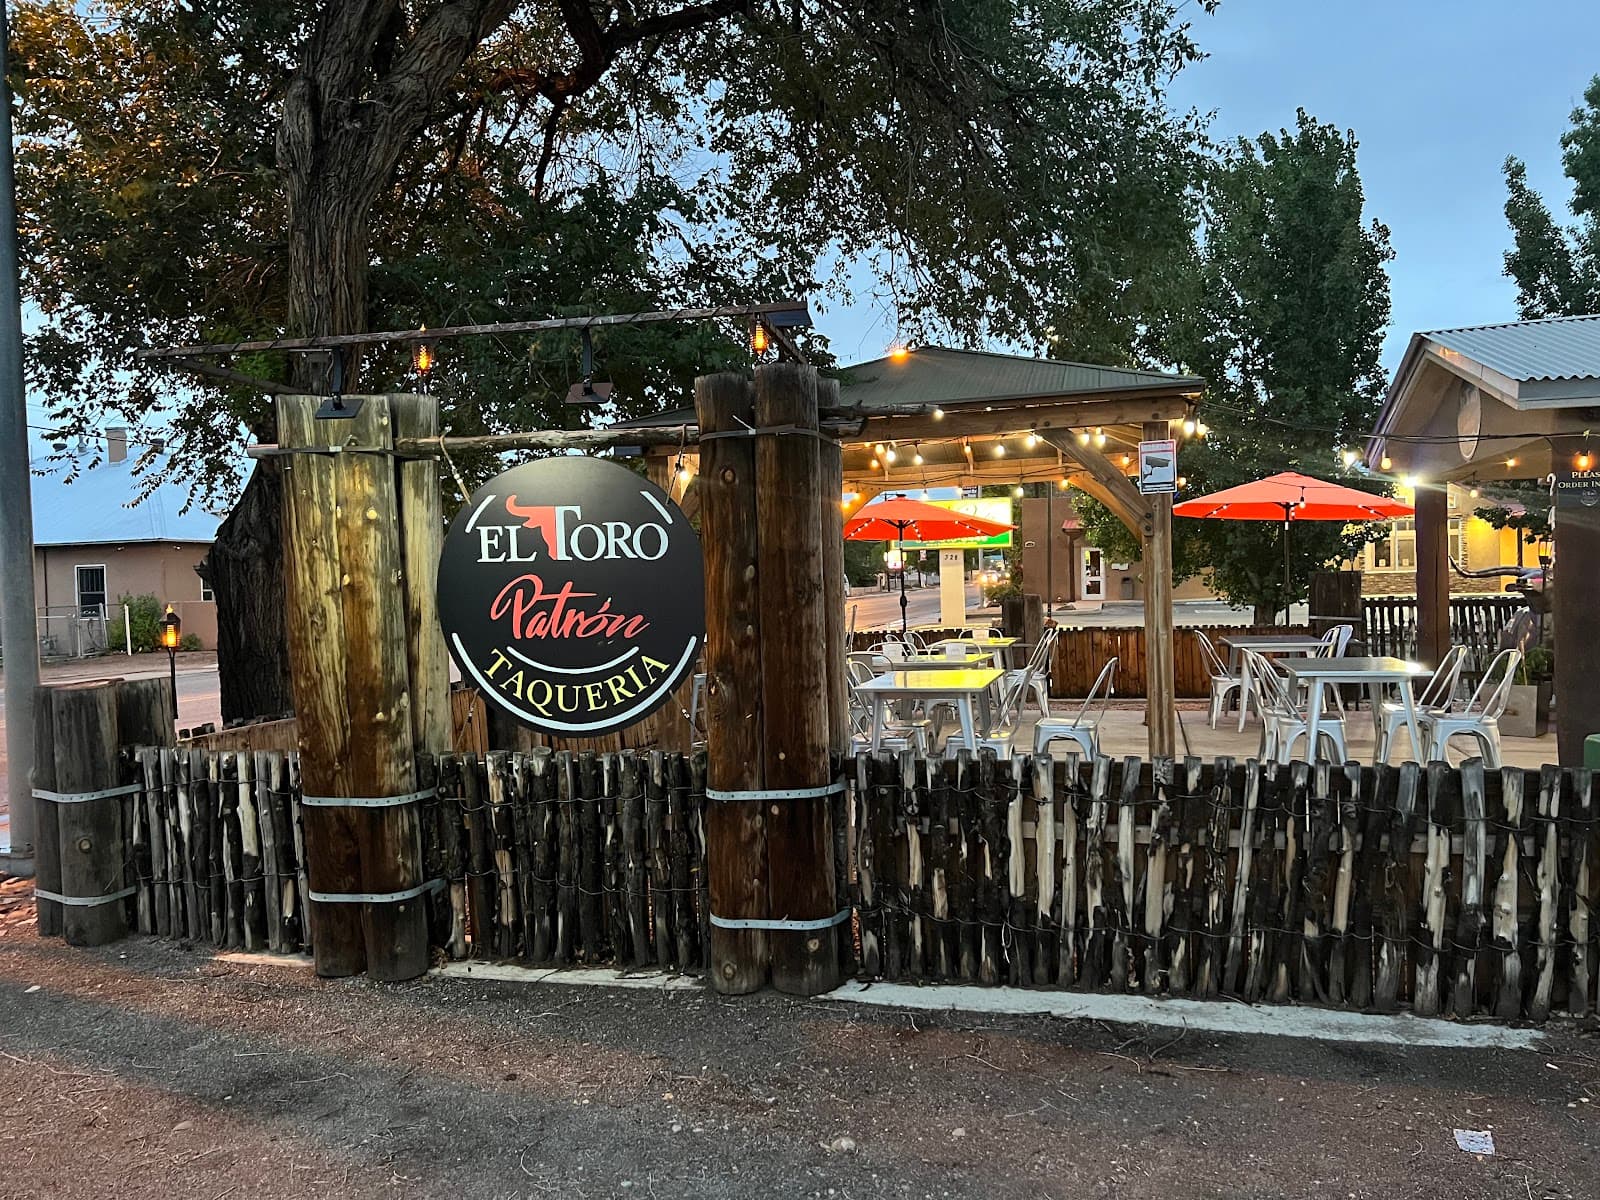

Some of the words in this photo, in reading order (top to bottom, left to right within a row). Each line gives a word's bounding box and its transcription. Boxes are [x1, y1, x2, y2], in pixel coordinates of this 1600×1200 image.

[1558, 481, 1589, 489] ORDER
[476, 524, 538, 563] EL
[522, 504, 669, 561] TORO
[490, 574, 650, 640] Patrón
[483, 648, 671, 717] TAQUERIA
